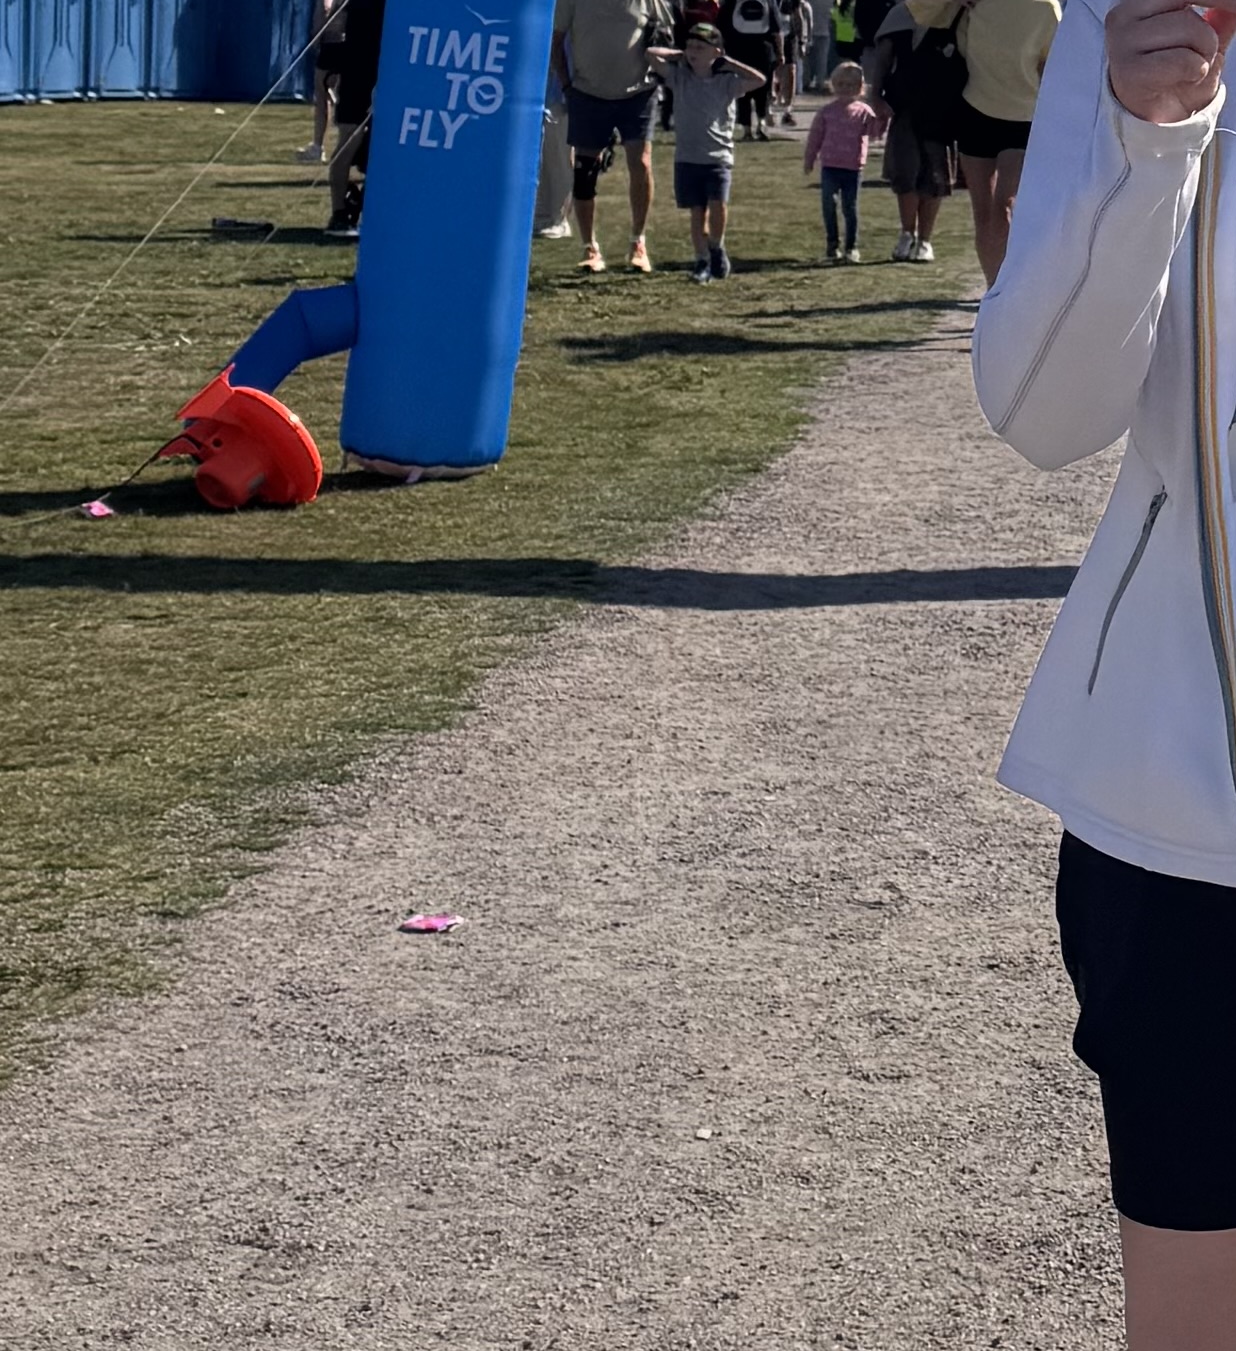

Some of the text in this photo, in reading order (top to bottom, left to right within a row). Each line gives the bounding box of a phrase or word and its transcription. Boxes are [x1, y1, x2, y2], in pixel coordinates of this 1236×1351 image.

[408, 25, 510, 74] TIME
[446, 72, 505, 115] TO
[398, 106, 470, 150] FLY
